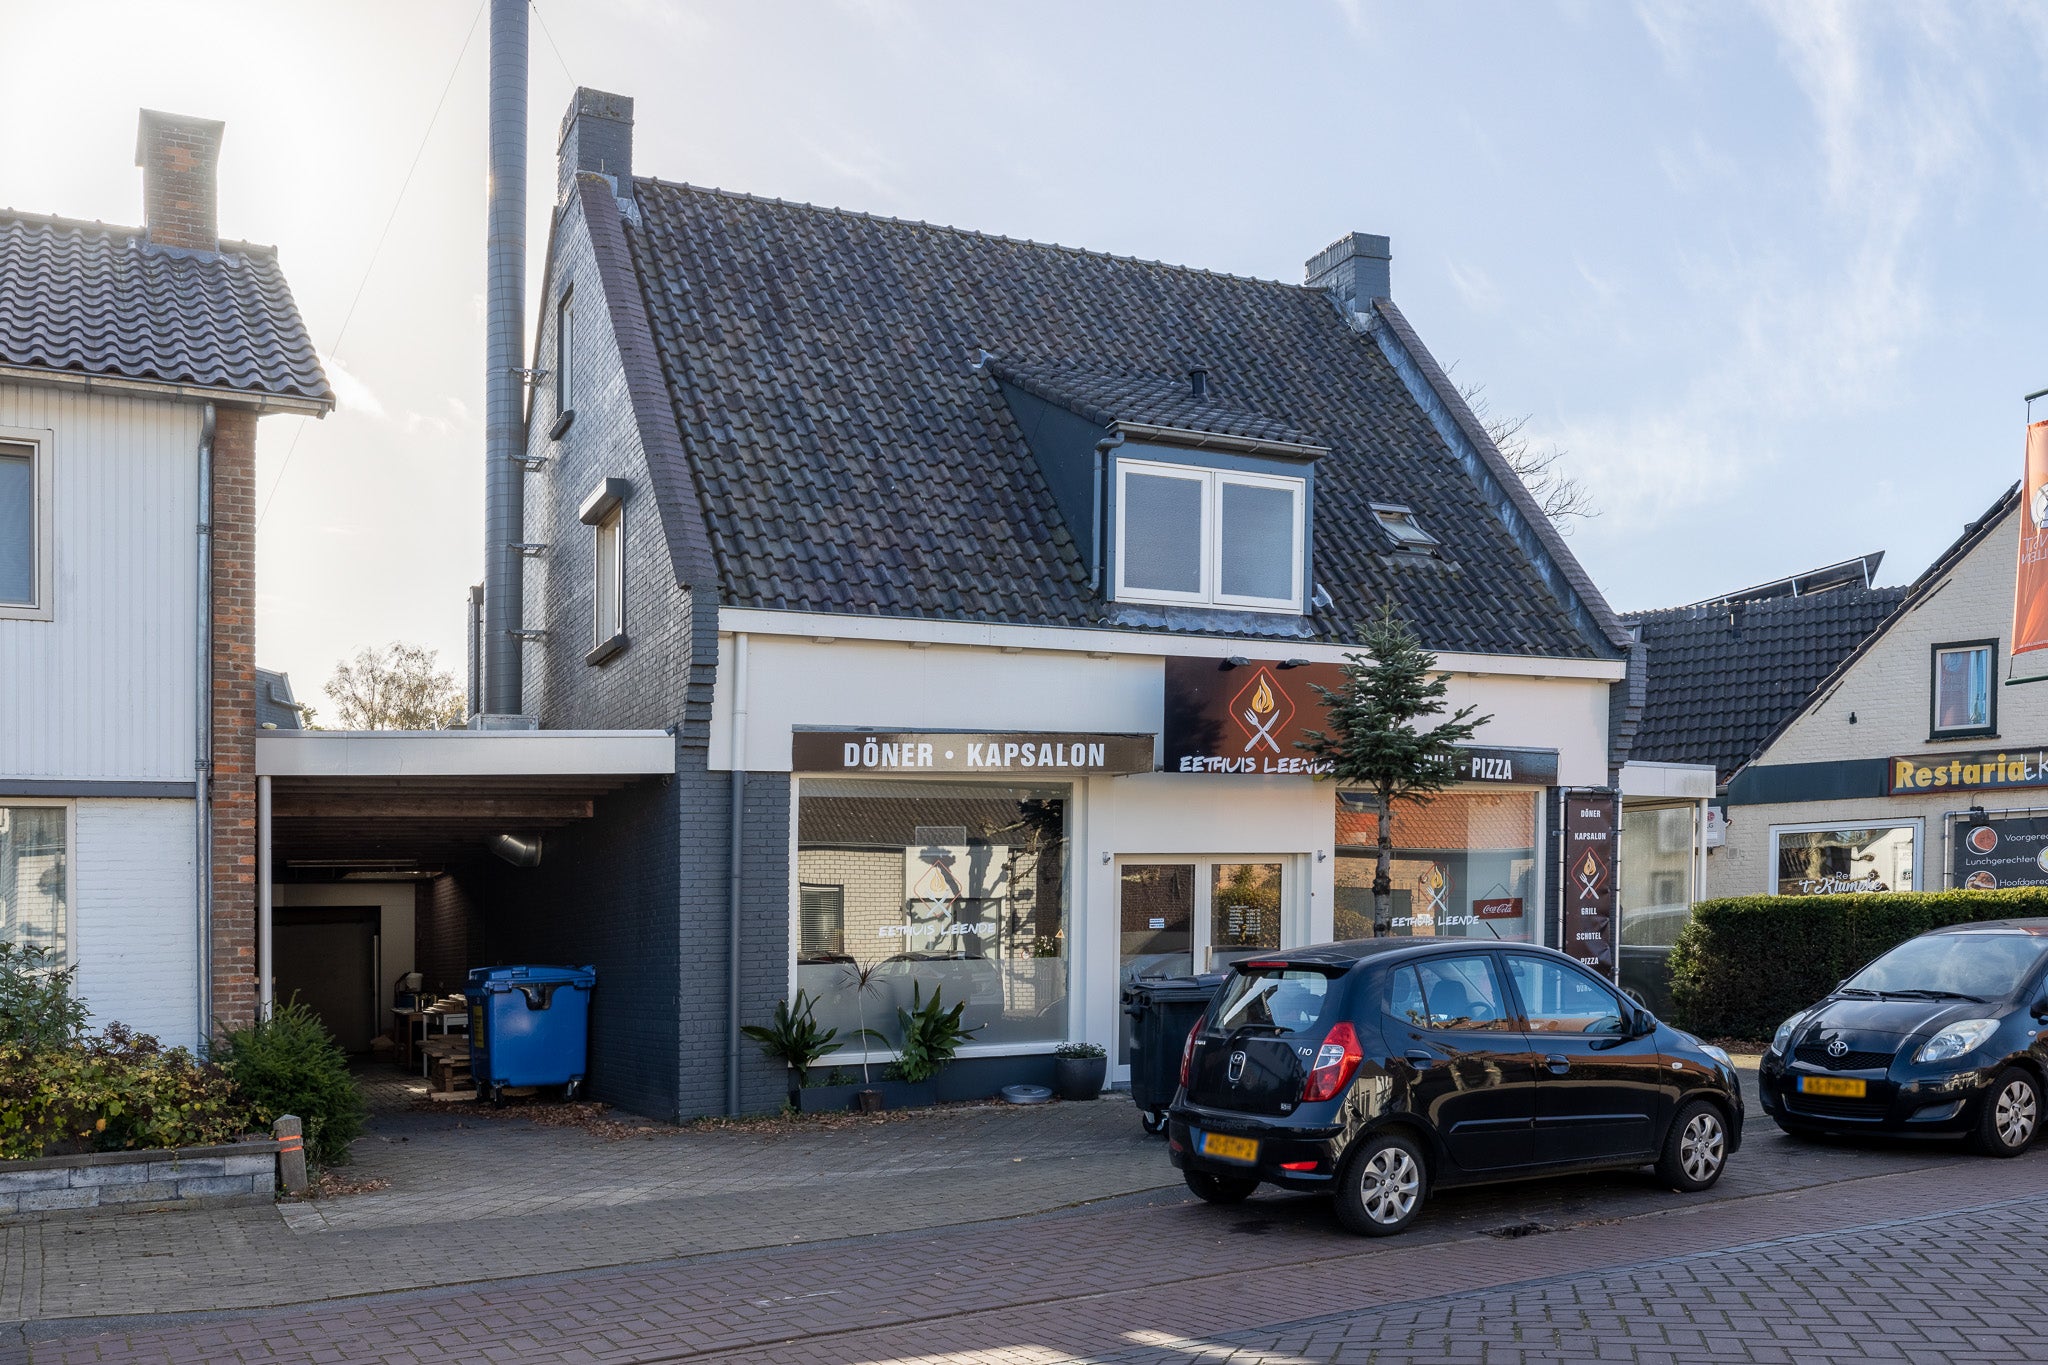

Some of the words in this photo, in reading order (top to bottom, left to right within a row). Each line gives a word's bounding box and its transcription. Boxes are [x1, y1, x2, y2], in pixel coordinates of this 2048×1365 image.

[844, 737, 933, 767] DÖNER
[967, 743, 1105, 767] KAPSALON
[1179, 755, 1257, 773] EETHUIS
[1472, 757, 1513, 780] PIZZA
[1895, 753, 2025, 788] Restaria
[1580, 808, 1601, 818] DÖNER
[1574, 832, 1607, 841] KAPSALON
[1965, 855, 2036, 867] Lunchgerechten
[1580, 907, 1598, 916] GRILL
[1437, 915, 1480, 926] LEENDE
[878, 923, 935, 937] EETHUIS
[940, 922, 997, 935] LEENDE
[1575, 932, 1602, 941] SCHOTEL
[1580, 956, 1599, 965] PIZZA
